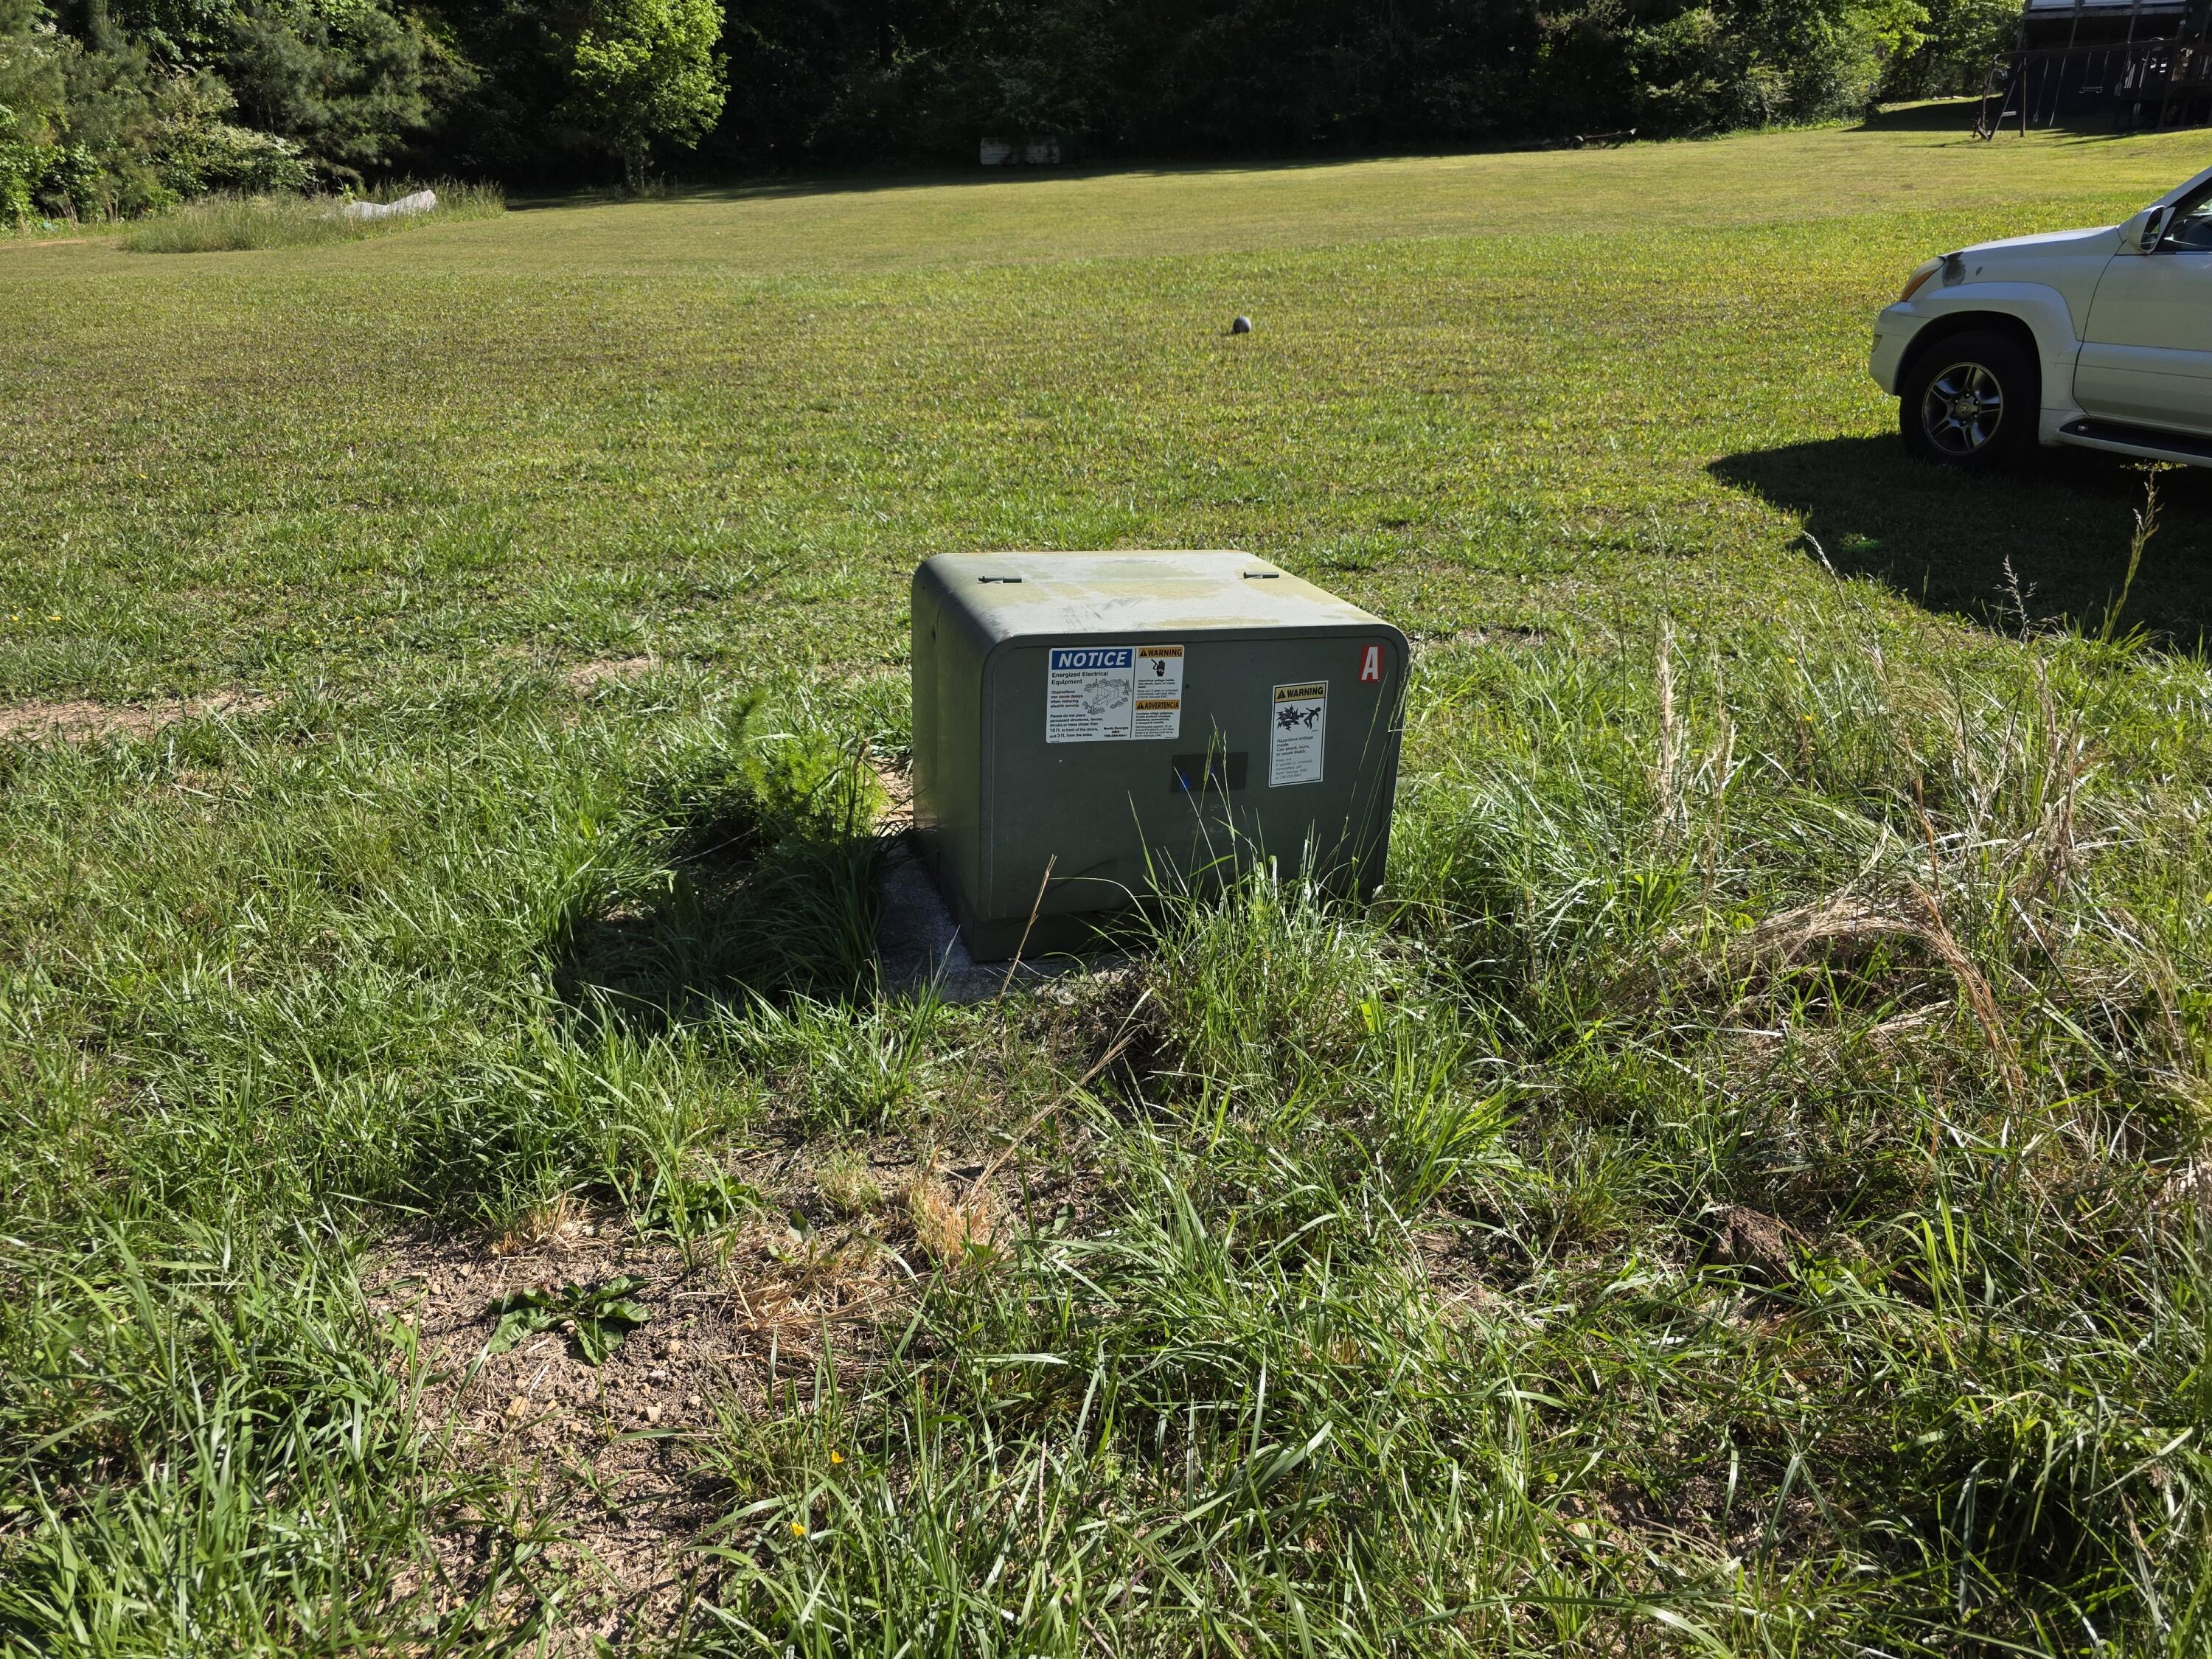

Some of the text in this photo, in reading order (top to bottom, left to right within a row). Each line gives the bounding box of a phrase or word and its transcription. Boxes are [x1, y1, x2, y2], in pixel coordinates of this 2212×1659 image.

[1058, 651, 1127, 667] NOTICE
[1361, 647, 1378, 680] A
[1287, 687, 1323, 698] WARNING
